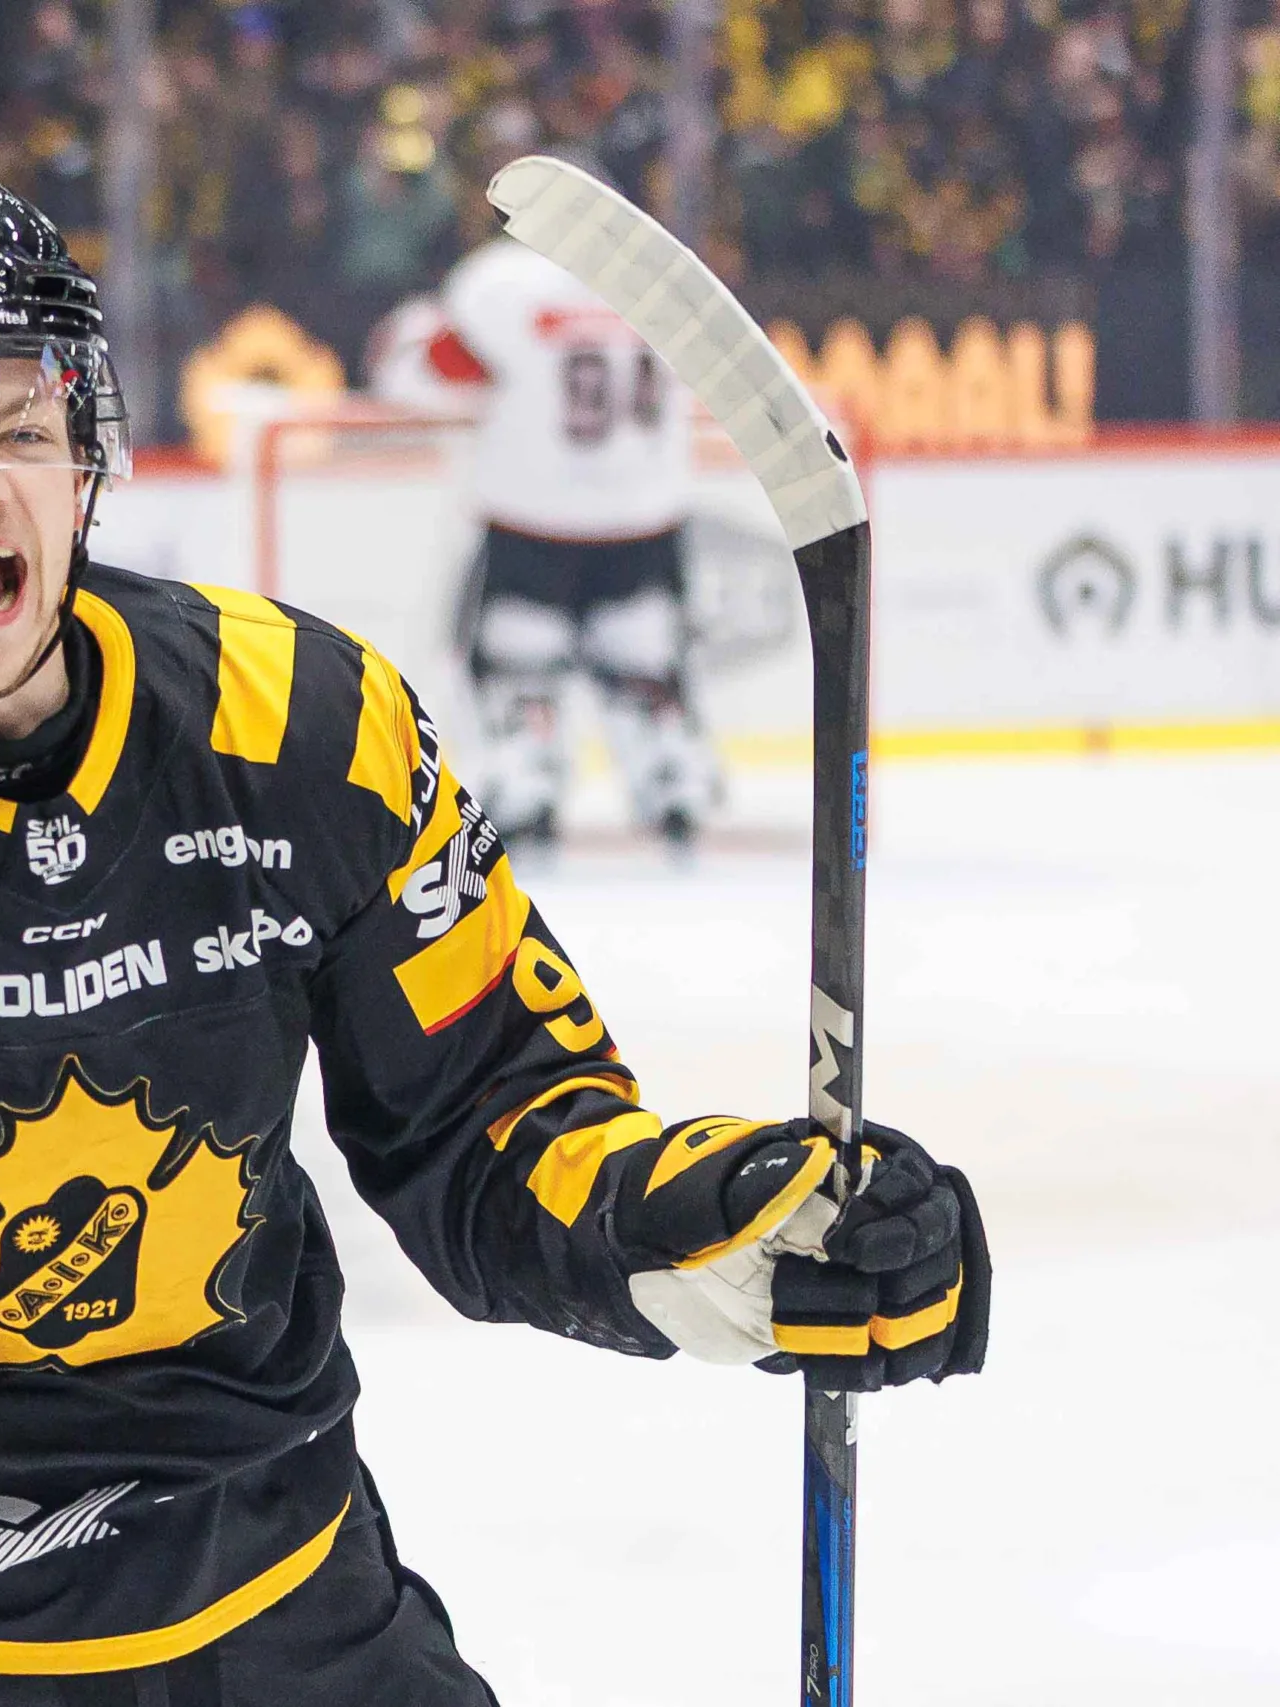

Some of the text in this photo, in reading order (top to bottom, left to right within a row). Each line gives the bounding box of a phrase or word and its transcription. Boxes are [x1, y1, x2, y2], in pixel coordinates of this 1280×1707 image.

[26, 814, 81, 839] SHL
[26, 832, 86, 876] 50
[22, 912, 108, 945] CCM
[63, 1299, 118, 1322] 1921
